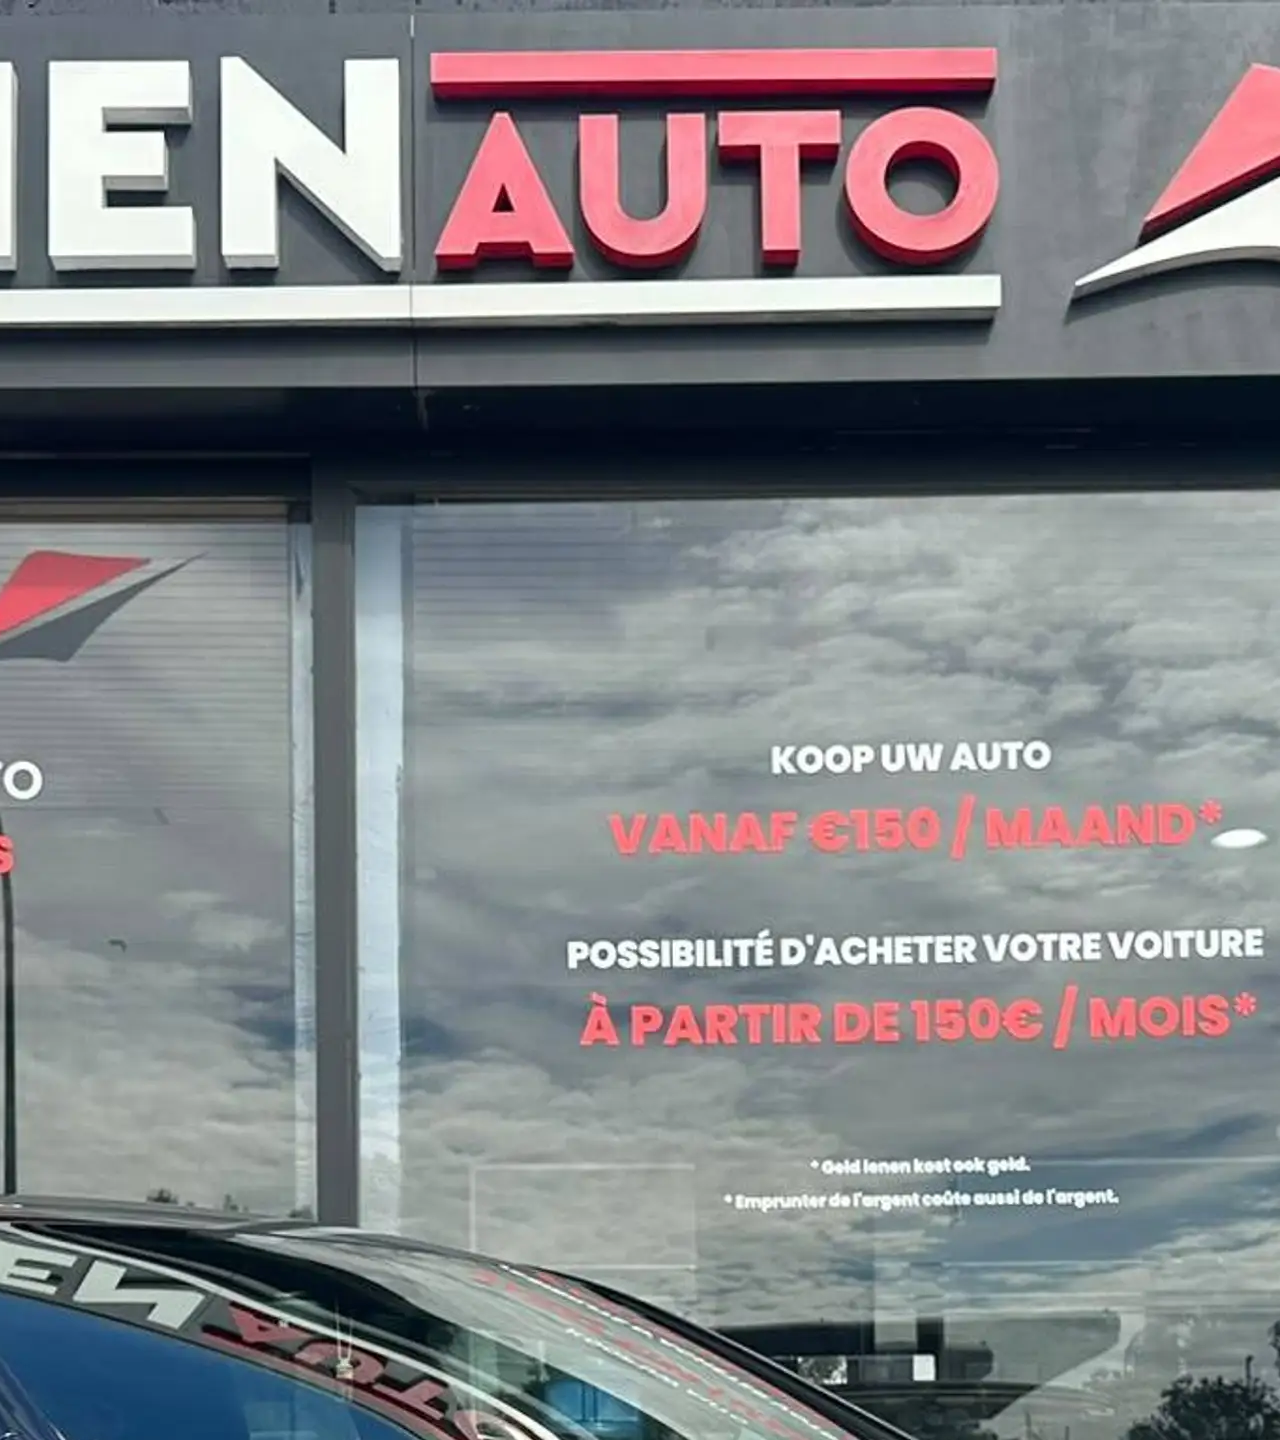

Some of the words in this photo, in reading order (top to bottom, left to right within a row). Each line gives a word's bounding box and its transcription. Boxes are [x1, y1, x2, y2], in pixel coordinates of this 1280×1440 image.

[771, 744, 876, 775] KOOP
[880, 742, 945, 773] UW
[949, 740, 1052, 772] AUTO
[609, 810, 798, 856] VANAF
[807, 806, 942, 853] €150
[950, 794, 977, 861] /
[567, 928, 775, 970] POSSIBILITÉ
[780, 933, 978, 966] D'ACHETER
[981, 931, 1102, 963] VOTRE
[1106, 927, 1264, 960] VOITURE
[579, 993, 620, 1047] À
[630, 1001, 824, 1049] PARTIR
[832, 999, 903, 1045] DE
[909, 995, 1043, 1044] 150€
[1053, 983, 1079, 1051] /
[820, 1158, 862, 1176] Geld
[862, 1158, 912, 1175] lenen
[912, 1157, 952, 1174] kost
[952, 1156, 986, 1173] ook
[986, 1155, 1031, 1177] geld.
[734, 1193, 828, 1214] Emprunter
[827, 1191, 852, 1209] de
[852, 1191, 921, 1213] l'argent
[921, 1189, 972, 1208] coûte
[972, 1188, 1021, 1206] aussi
[1021, 1189, 1045, 1206] de
[1046, 1187, 1120, 1209] l'argent.
